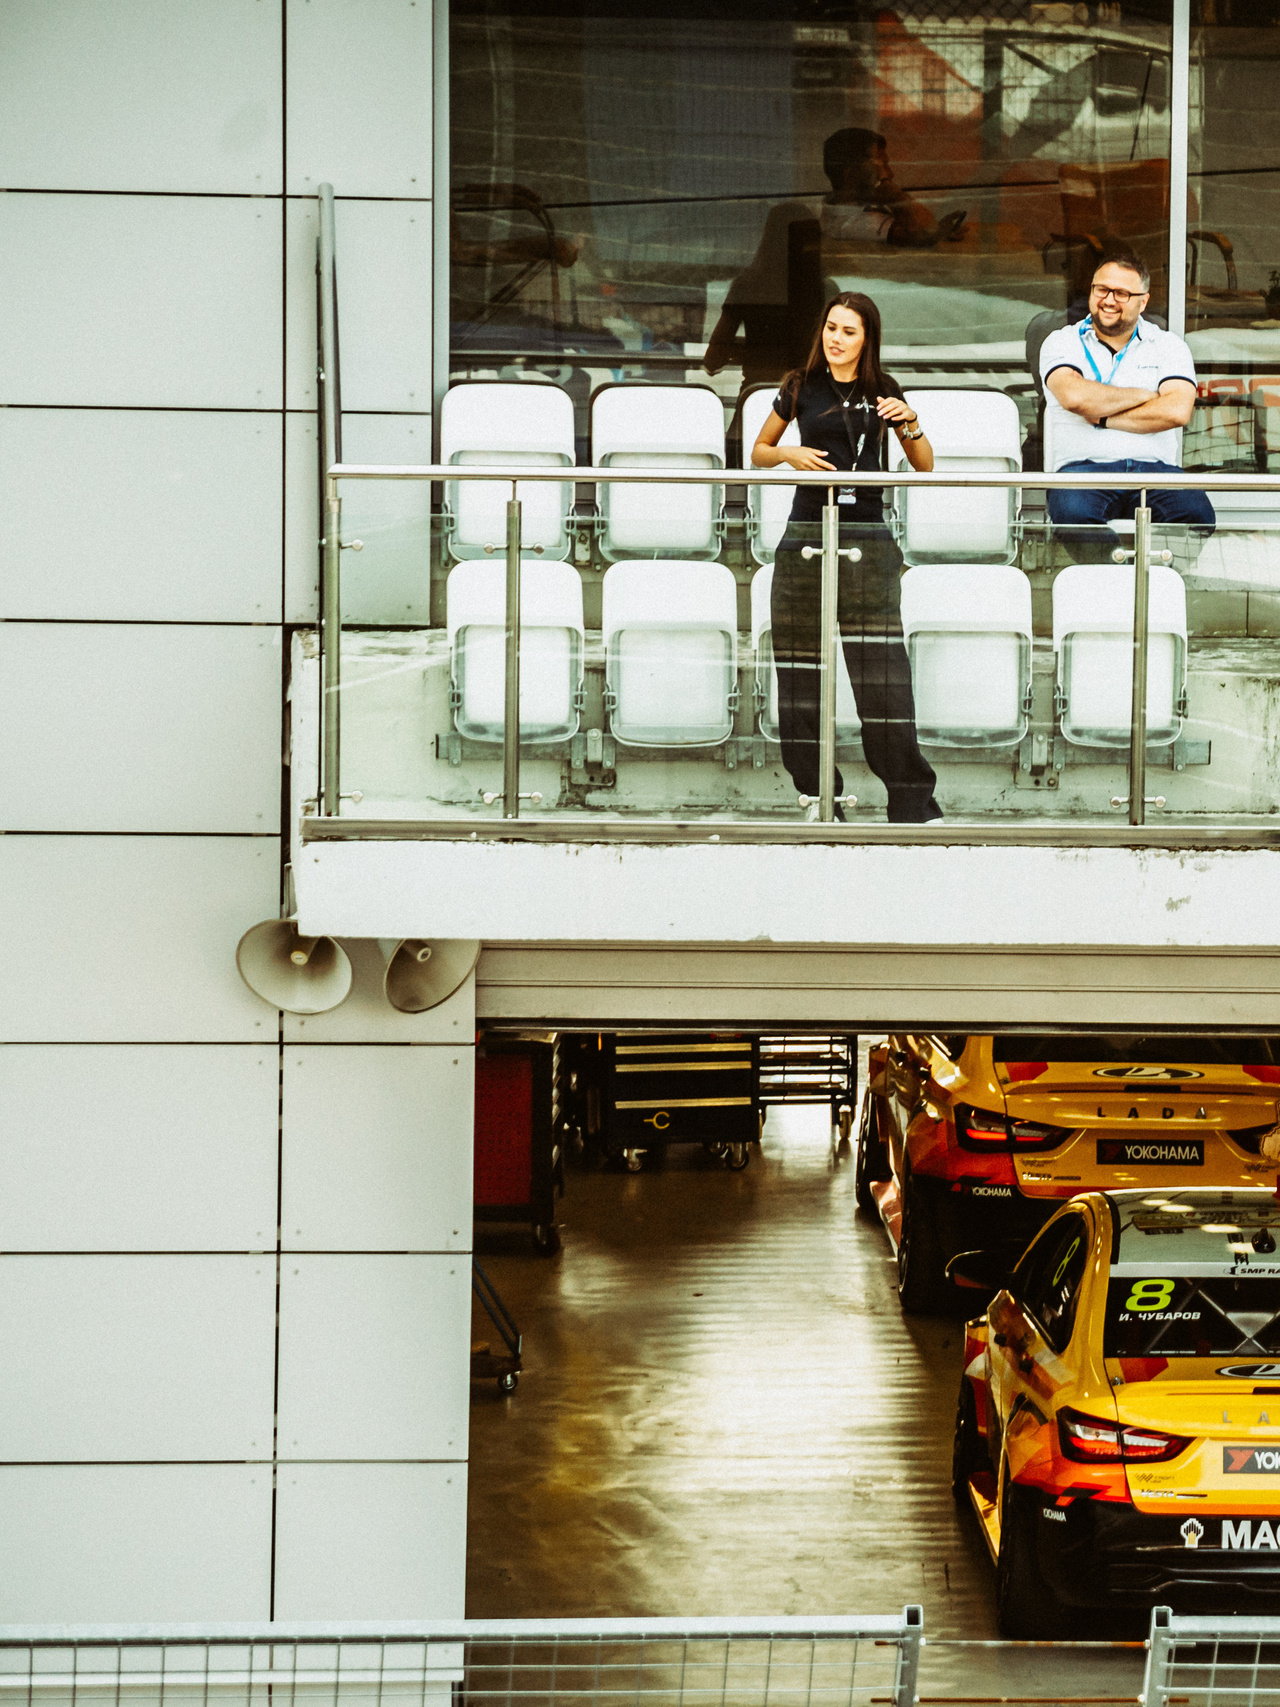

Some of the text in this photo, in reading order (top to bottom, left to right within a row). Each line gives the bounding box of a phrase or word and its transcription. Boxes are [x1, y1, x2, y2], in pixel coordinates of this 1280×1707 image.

[1097, 1106, 1207, 1119] LADA
[1124, 1145, 1199, 1160] YOKOHAMA
[972, 1186, 1012, 1197] YOKOHAMA
[1125, 1279, 1175, 1312] 8
[1119, 1312, 1201, 1322] И. ЧУБАРОВ
